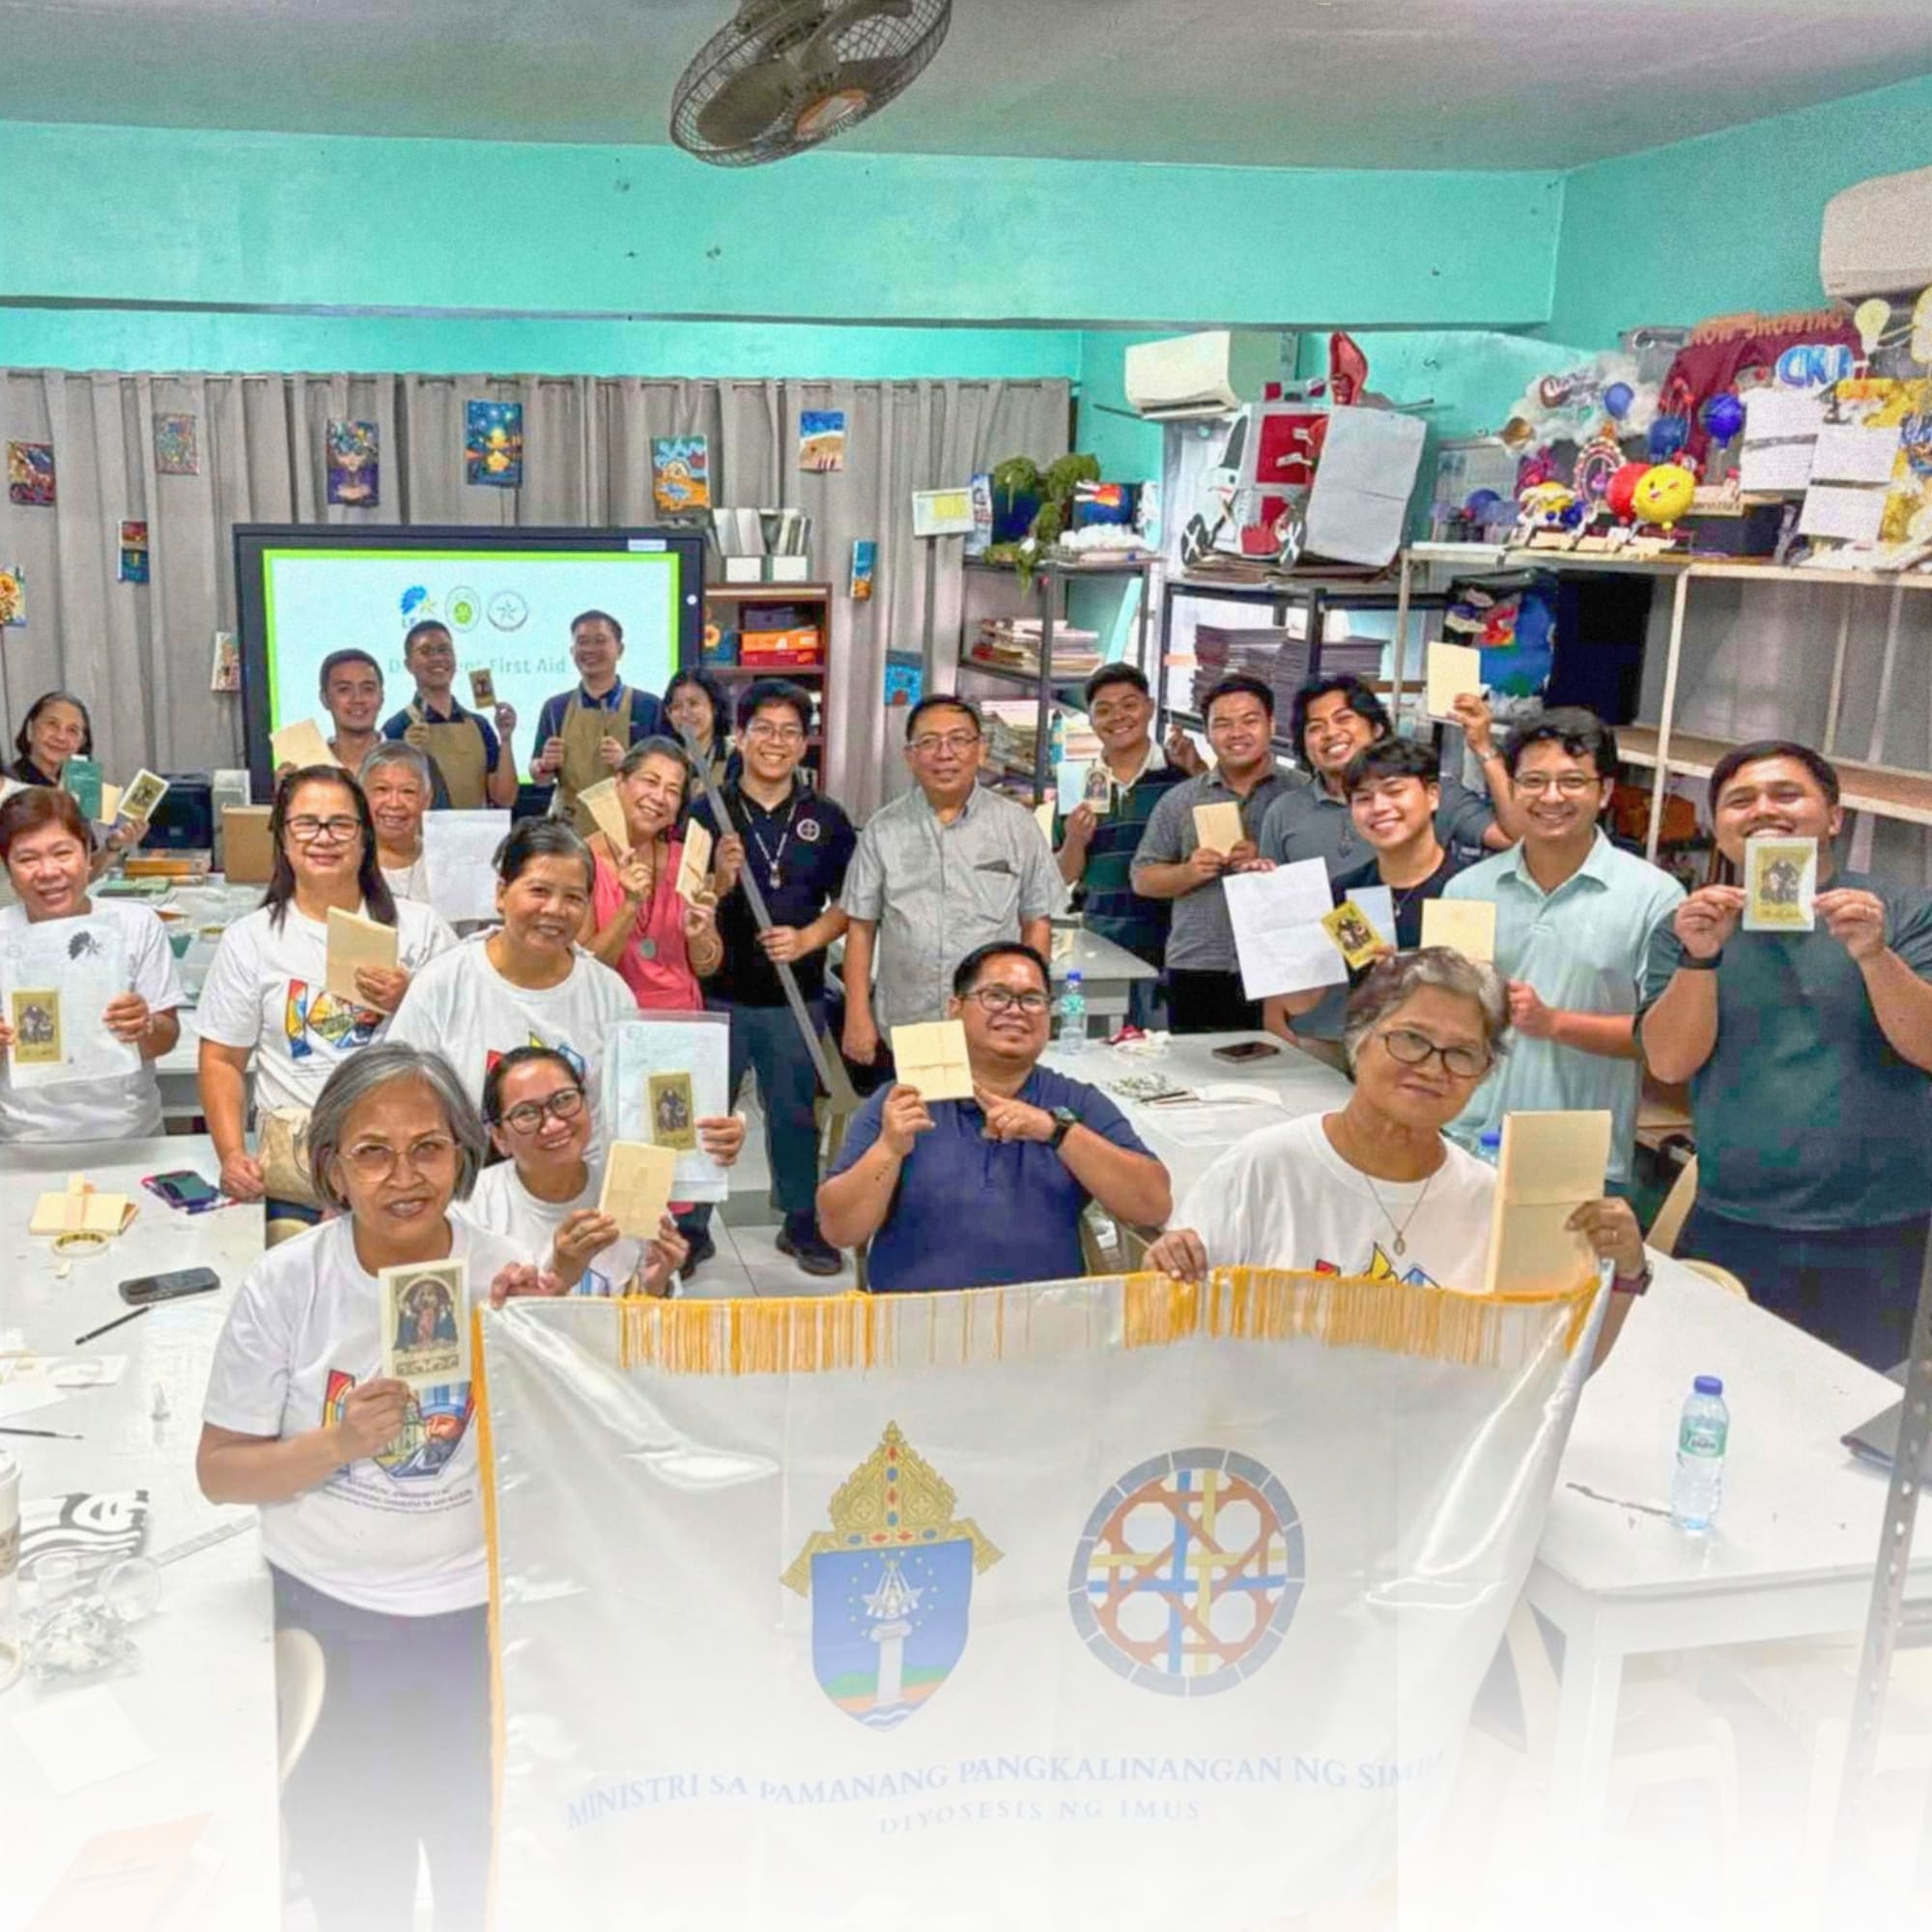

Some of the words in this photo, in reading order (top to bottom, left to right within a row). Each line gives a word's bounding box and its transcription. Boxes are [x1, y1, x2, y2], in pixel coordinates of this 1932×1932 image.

[490, 658, 531, 673] First
[535, 657, 566, 673] Aid
[567, 1773, 699, 1830] MINISTRI
[709, 1774, 749, 1796] SA
[760, 1764, 949, 1805] PAMANANG
[957, 1754, 1283, 1784] PANGKALINANGAN
[1293, 1756, 1347, 1787] NG
[879, 1800, 1042, 1834] DIYOSESIS
[1059, 1800, 1103, 1820] NG
[1120, 1799, 1199, 1820] IMUS
